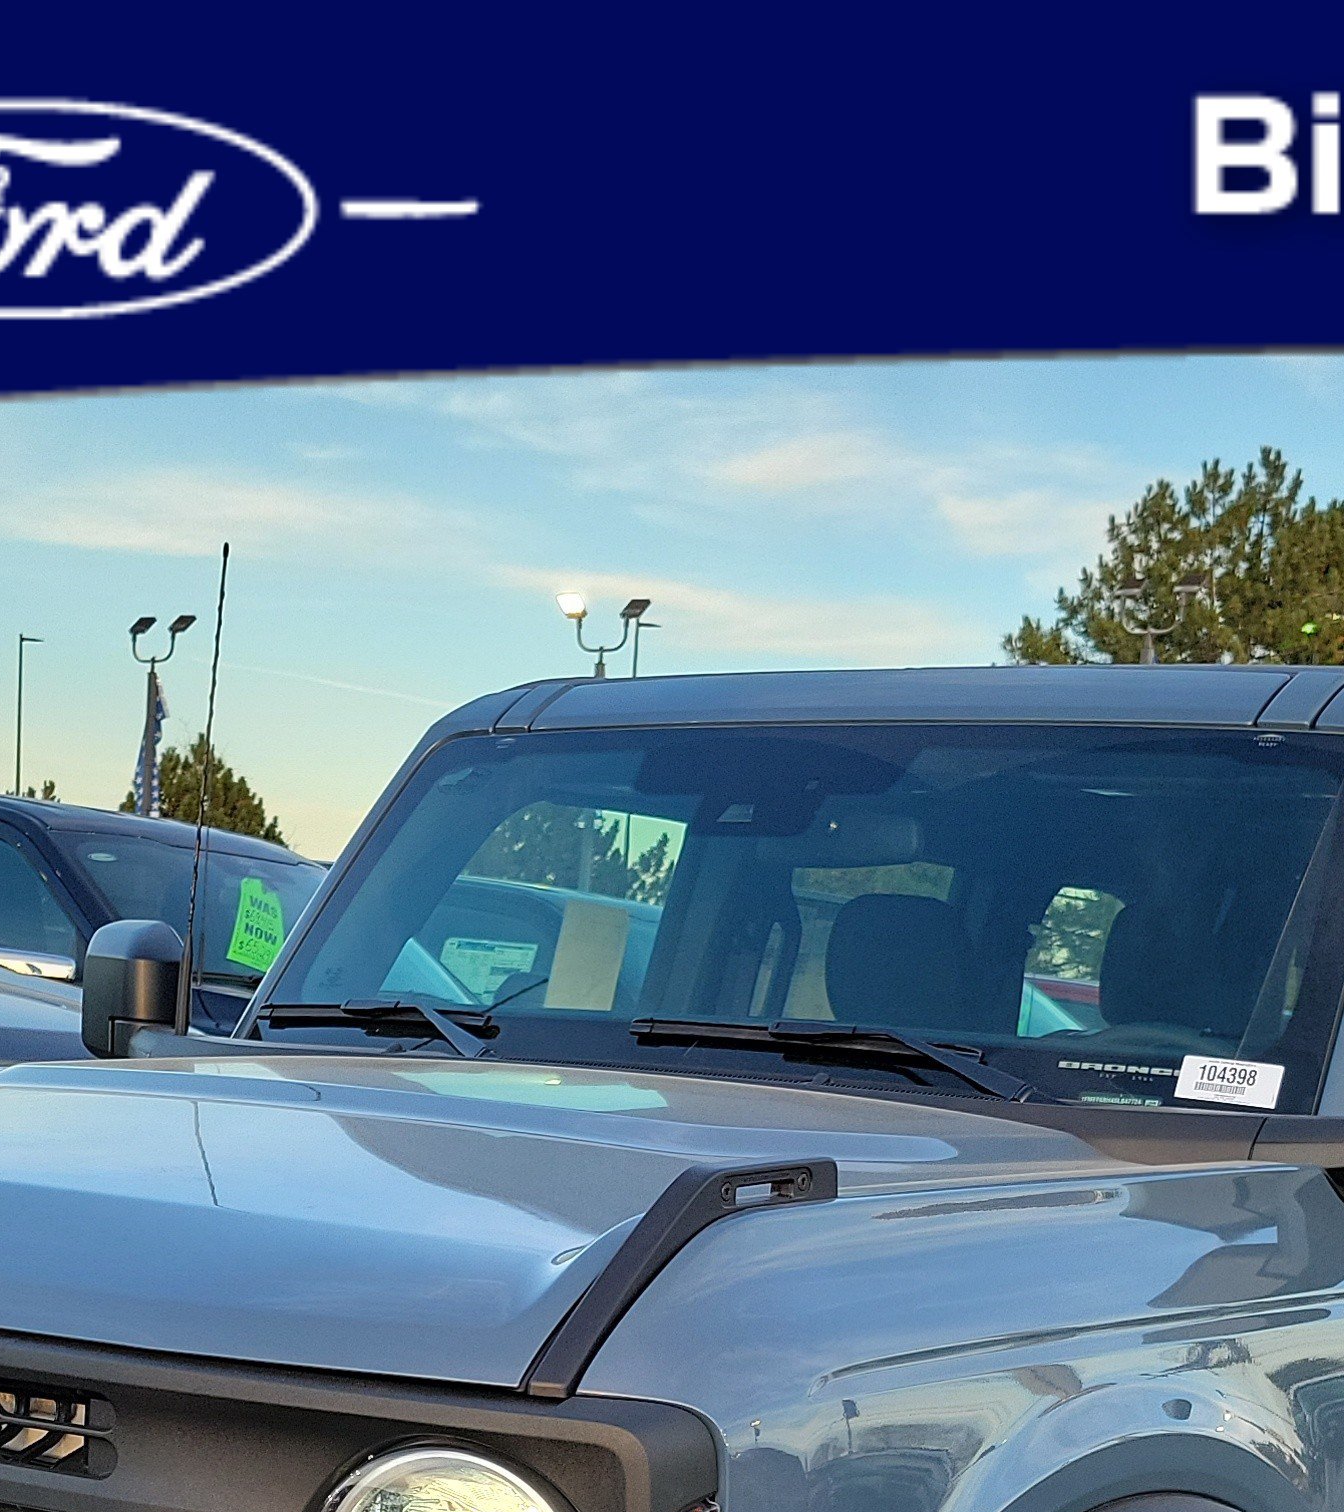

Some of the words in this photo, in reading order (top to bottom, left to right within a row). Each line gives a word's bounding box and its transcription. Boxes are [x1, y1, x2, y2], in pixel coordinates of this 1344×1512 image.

[250, 895, 278, 919] WAS
[244, 922, 277, 945] NOW
[1058, 1061, 1180, 1076] BRONC
[1199, 1065, 1258, 1086] 104398
